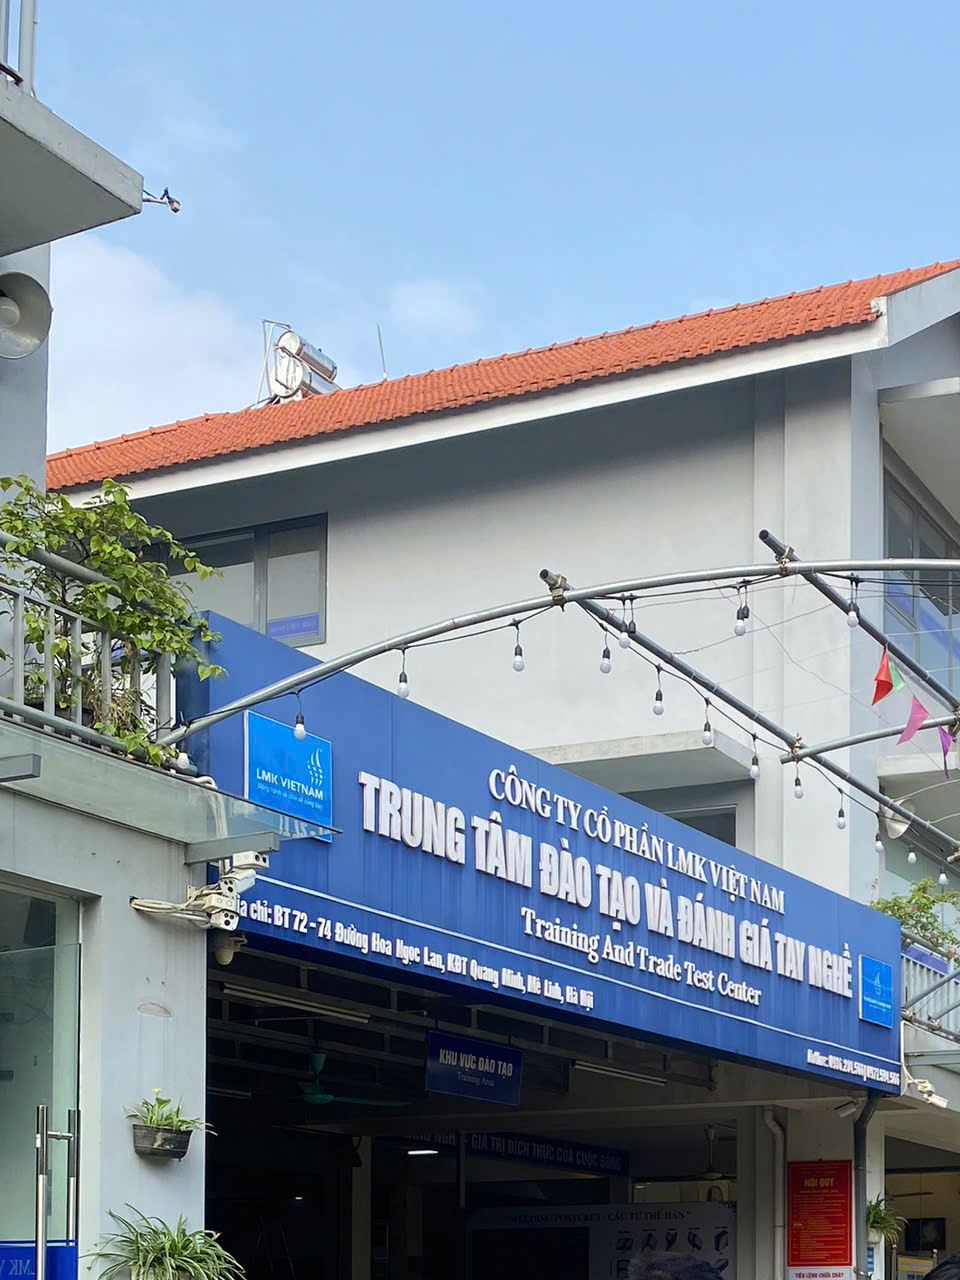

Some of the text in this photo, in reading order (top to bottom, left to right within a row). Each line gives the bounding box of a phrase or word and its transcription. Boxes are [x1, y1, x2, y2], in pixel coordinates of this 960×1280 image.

[257, 768, 323, 800] LMK VIETNAM
[358, 771, 853, 999] TRUNG TÂM ĐÀO TẠO VÀ ĐÁNH GIÁ TAY NGHỀ
[489, 764, 785, 915] CÔNG TY CỔ PHẦN LMK VIỆT NAM
[274, 904, 291, 929] BT
[293, 911, 308, 934] 72
[317, 917, 332, 940] 74
[371, 932, 392, 956] Hoa
[396, 938, 420, 965] Ngọc
[447, 953, 468, 976] KĐT
[470, 959, 499, 989] Quang
[527, 974, 542, 994] Mê
[565, 985, 578, 1005] Hà
[580, 989, 594, 1012] Nội
[521, 906, 762, 1006] Training And Trade Test Center
[439, 1048, 513, 1079] KHU VỰC ĐÀO TẠO
